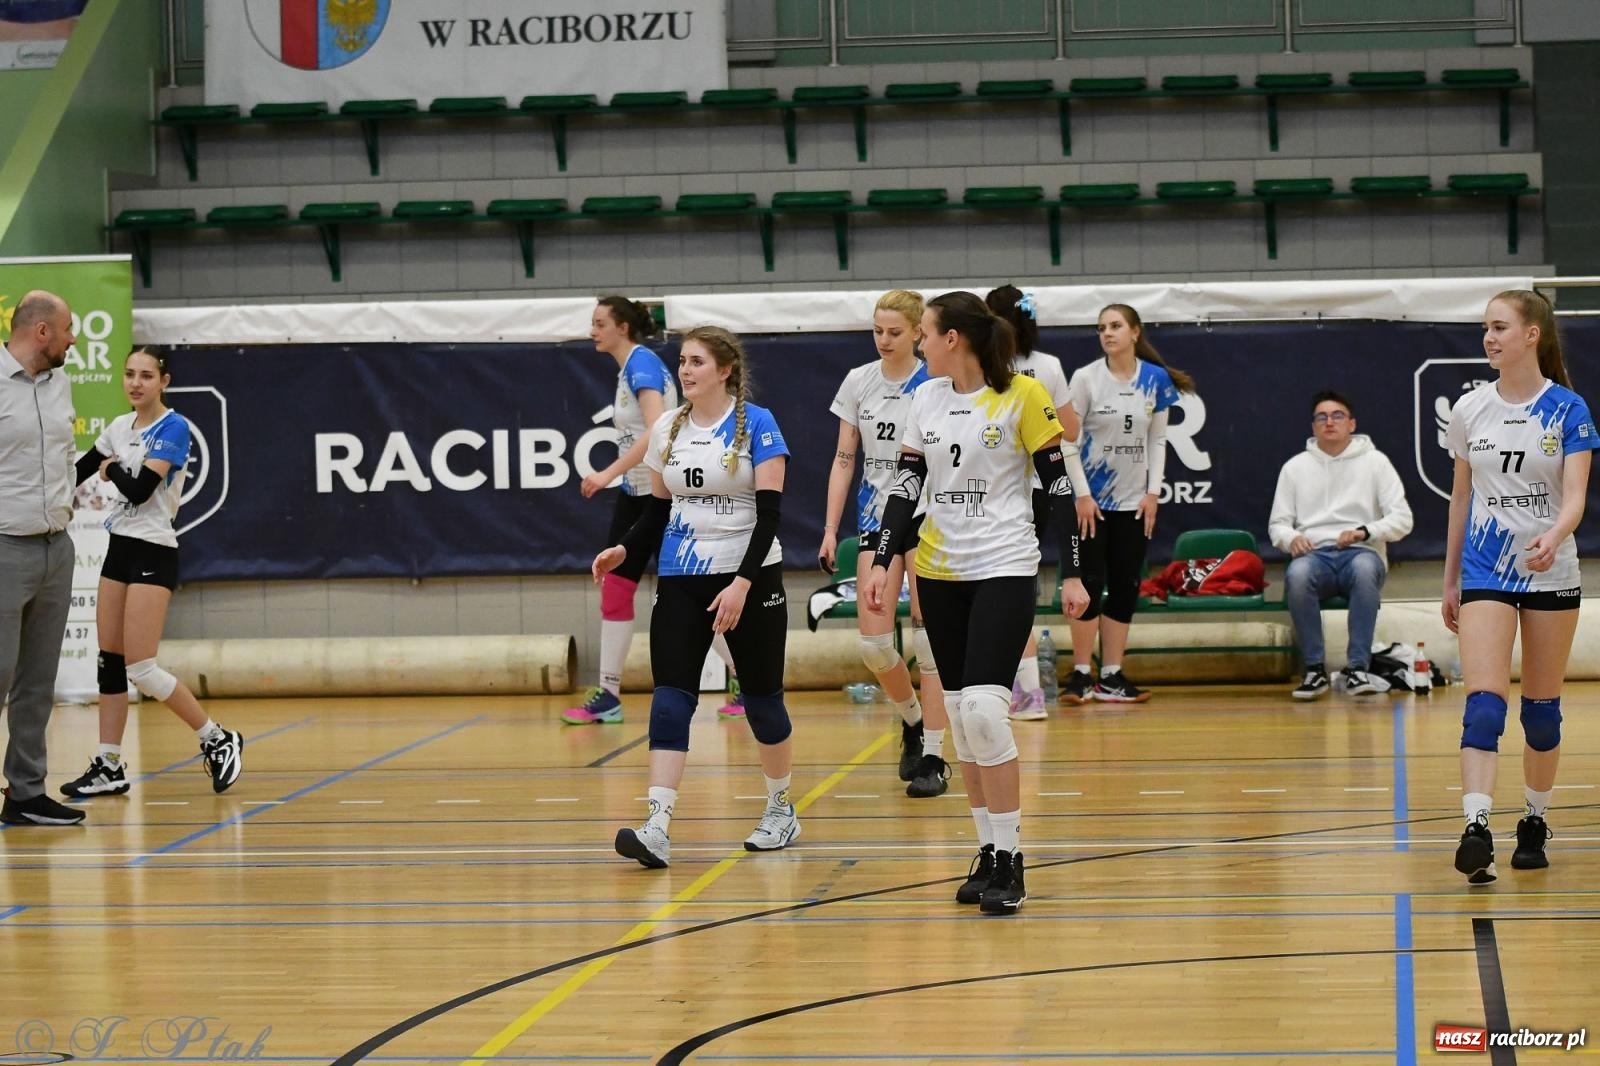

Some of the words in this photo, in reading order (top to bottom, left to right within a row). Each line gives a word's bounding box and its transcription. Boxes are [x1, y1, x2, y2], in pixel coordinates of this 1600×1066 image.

[418, 19, 457, 49] W
[468, 11, 694, 47] RACIBORZU
[876, 421, 896, 441] 22
[1124, 414, 1134, 431] 5
[950, 443, 962, 468] 2
[1499, 450, 1526, 474] 77
[682, 467, 705, 488] 16
[1071, 534, 1081, 567] ORACZ
